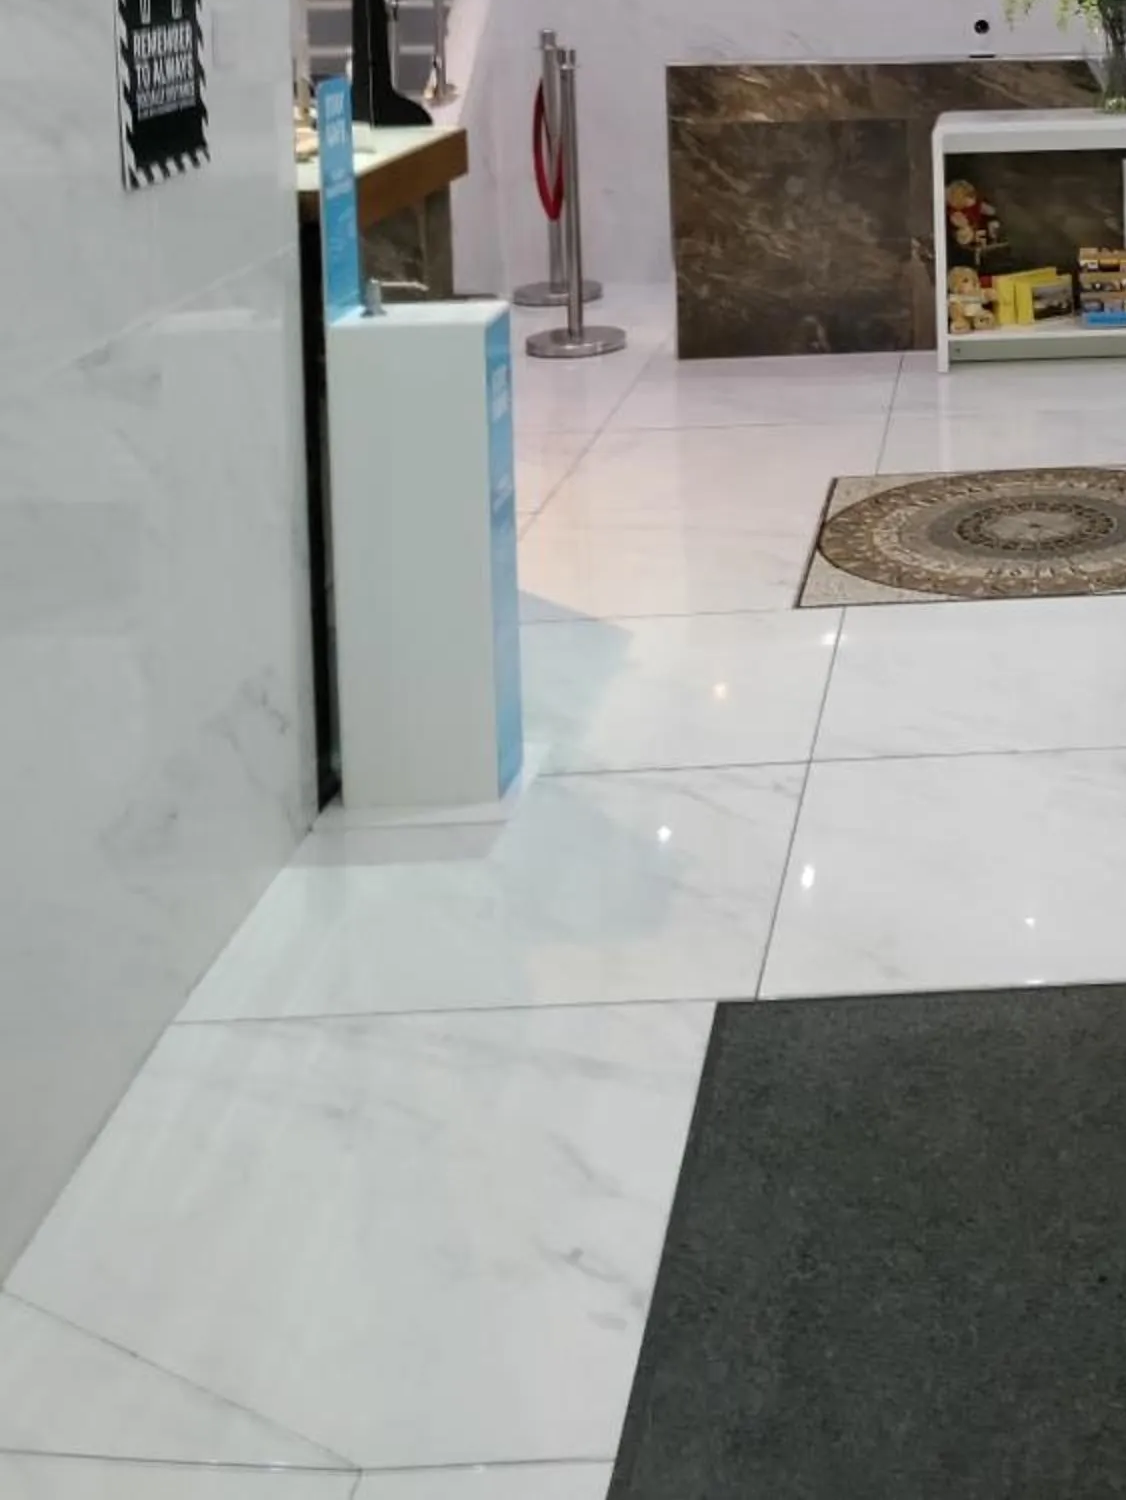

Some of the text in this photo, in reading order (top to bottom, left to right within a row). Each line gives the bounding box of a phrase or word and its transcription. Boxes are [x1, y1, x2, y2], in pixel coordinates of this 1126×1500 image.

[133, 22, 193, 57] REMEMBER
[136, 53, 194, 89] TO ALWAYS
